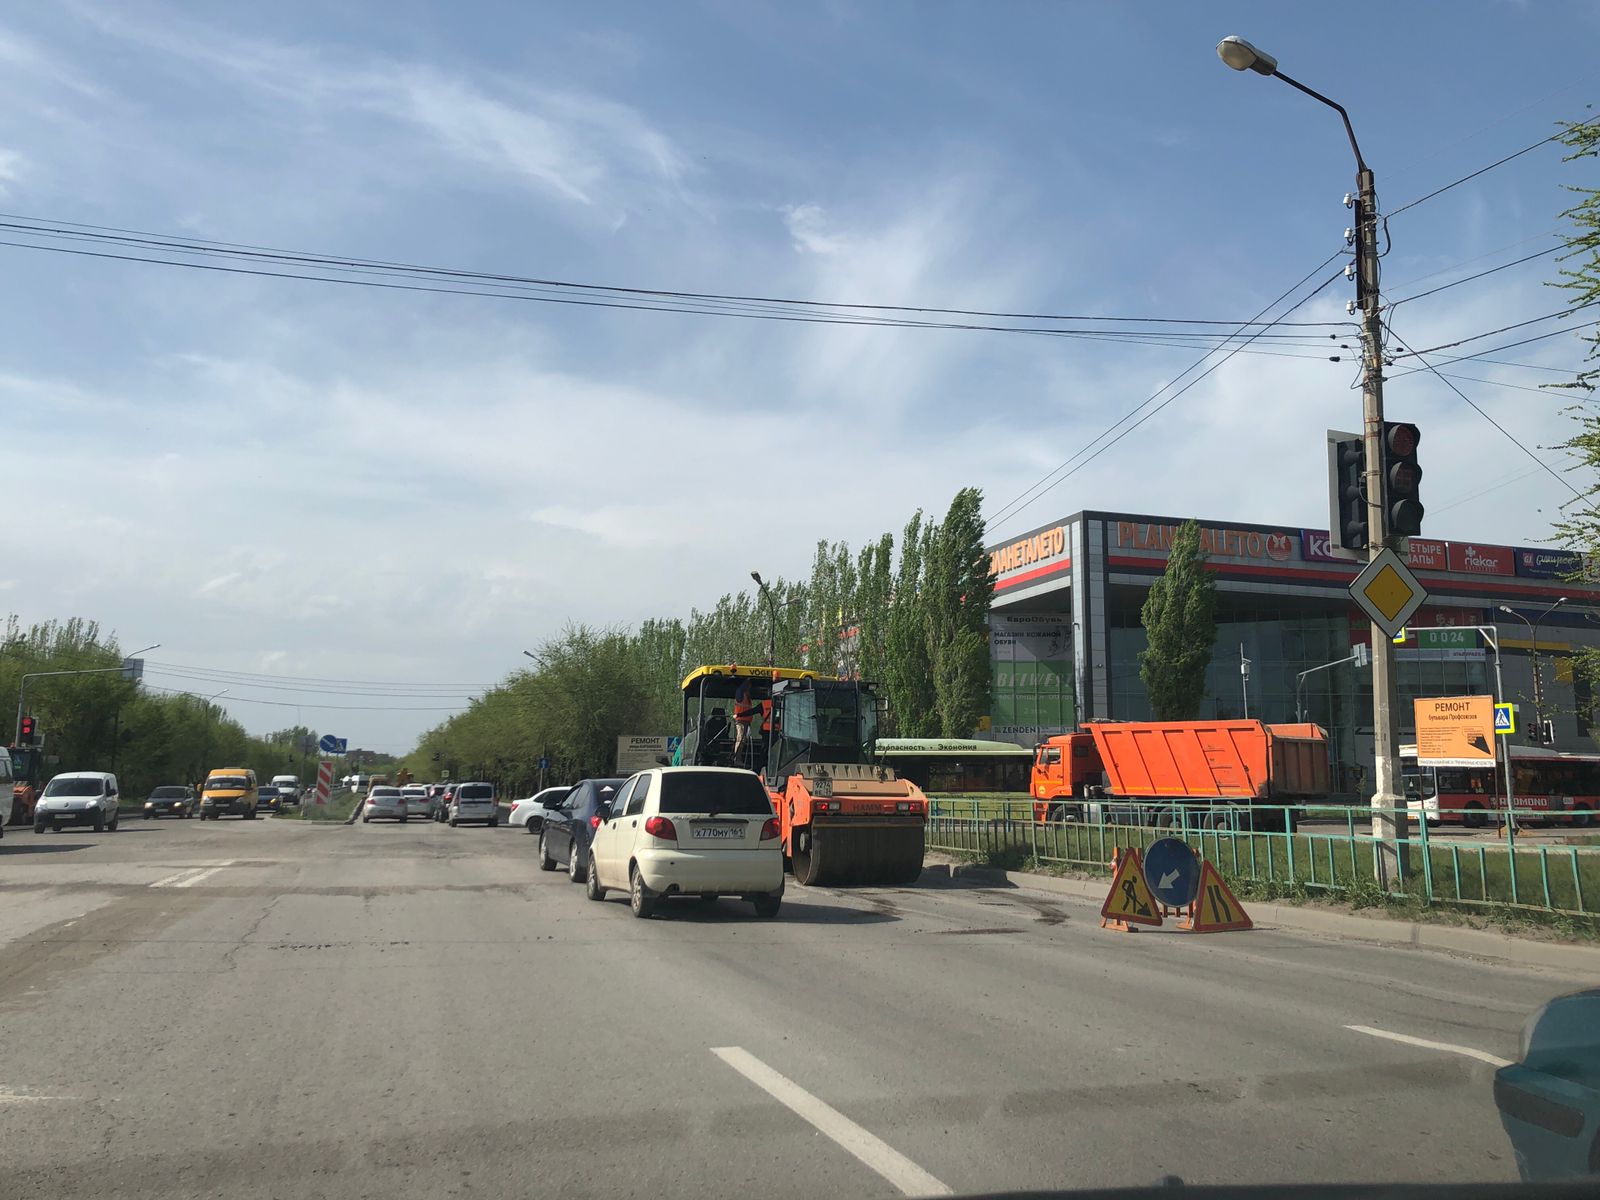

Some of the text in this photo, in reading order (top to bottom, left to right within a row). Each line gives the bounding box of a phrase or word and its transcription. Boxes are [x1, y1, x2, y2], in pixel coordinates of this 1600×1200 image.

[1118, 521, 1264, 559] PLANALETO
[1408, 543, 1441, 555] ЕТЫРЕ
[1464, 557, 1498, 568] rieker
[1434, 702, 1470, 712] РЕМОНТ
[1002, 726, 1036, 734] ZENDEN
[876, 743, 977, 752] езопасность Экономия
[1500, 797, 1548, 806] RDMOND
